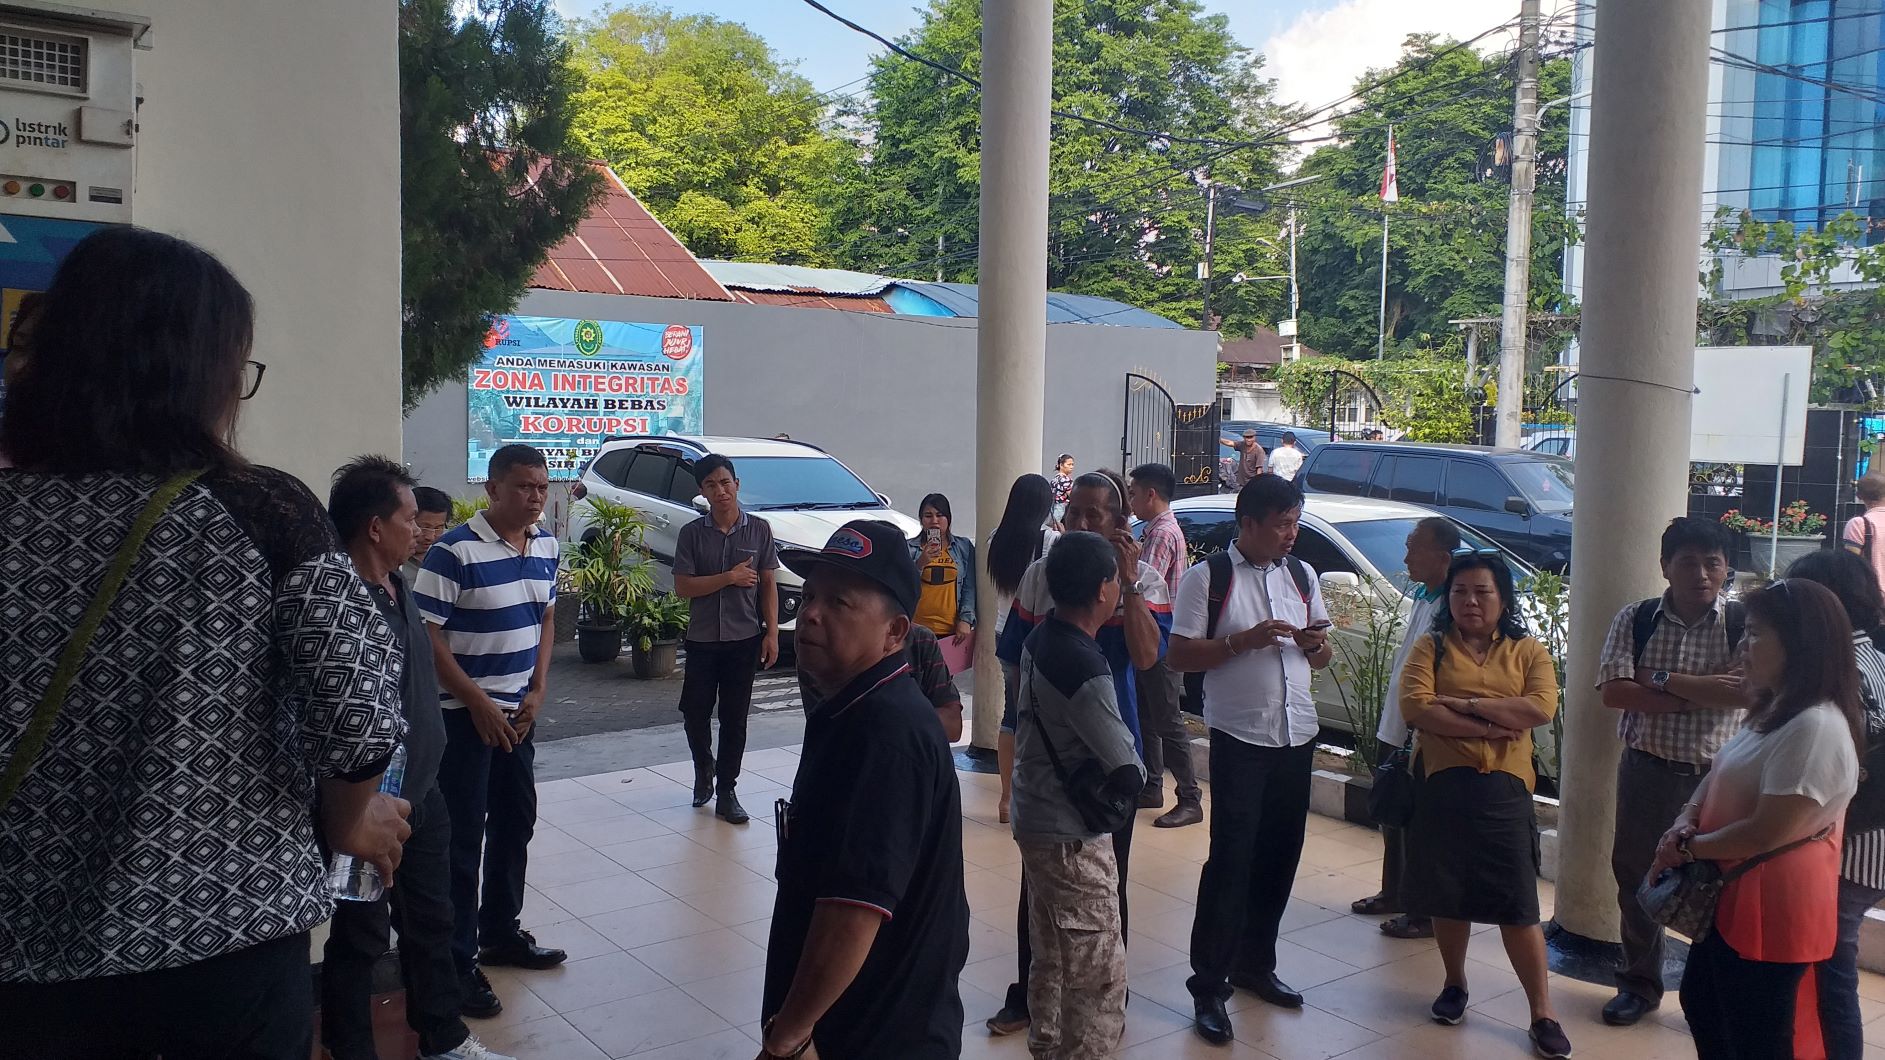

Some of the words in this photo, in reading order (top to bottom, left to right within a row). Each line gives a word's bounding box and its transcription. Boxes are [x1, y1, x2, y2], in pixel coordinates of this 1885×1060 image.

[16, 117, 68, 136] listrik
[15, 133, 68, 149] pintar
[495, 338, 521, 347] RUPSI
[496, 356, 533, 368] ANDA
[537, 358, 606, 370] MEMASUKI
[610, 361, 670, 373] KAWASAN
[474, 369, 545, 391] ZONA
[553, 372, 689, 396] INTEGRITAS
[504, 395, 598, 410] WILAYAH
[603, 398, 667, 411] BEBAS
[521, 415, 650, 433] KORUPSI
[576, 437, 600, 445] dan
[536, 448, 577, 457] AYAH
[547, 460, 576, 469] SIH
